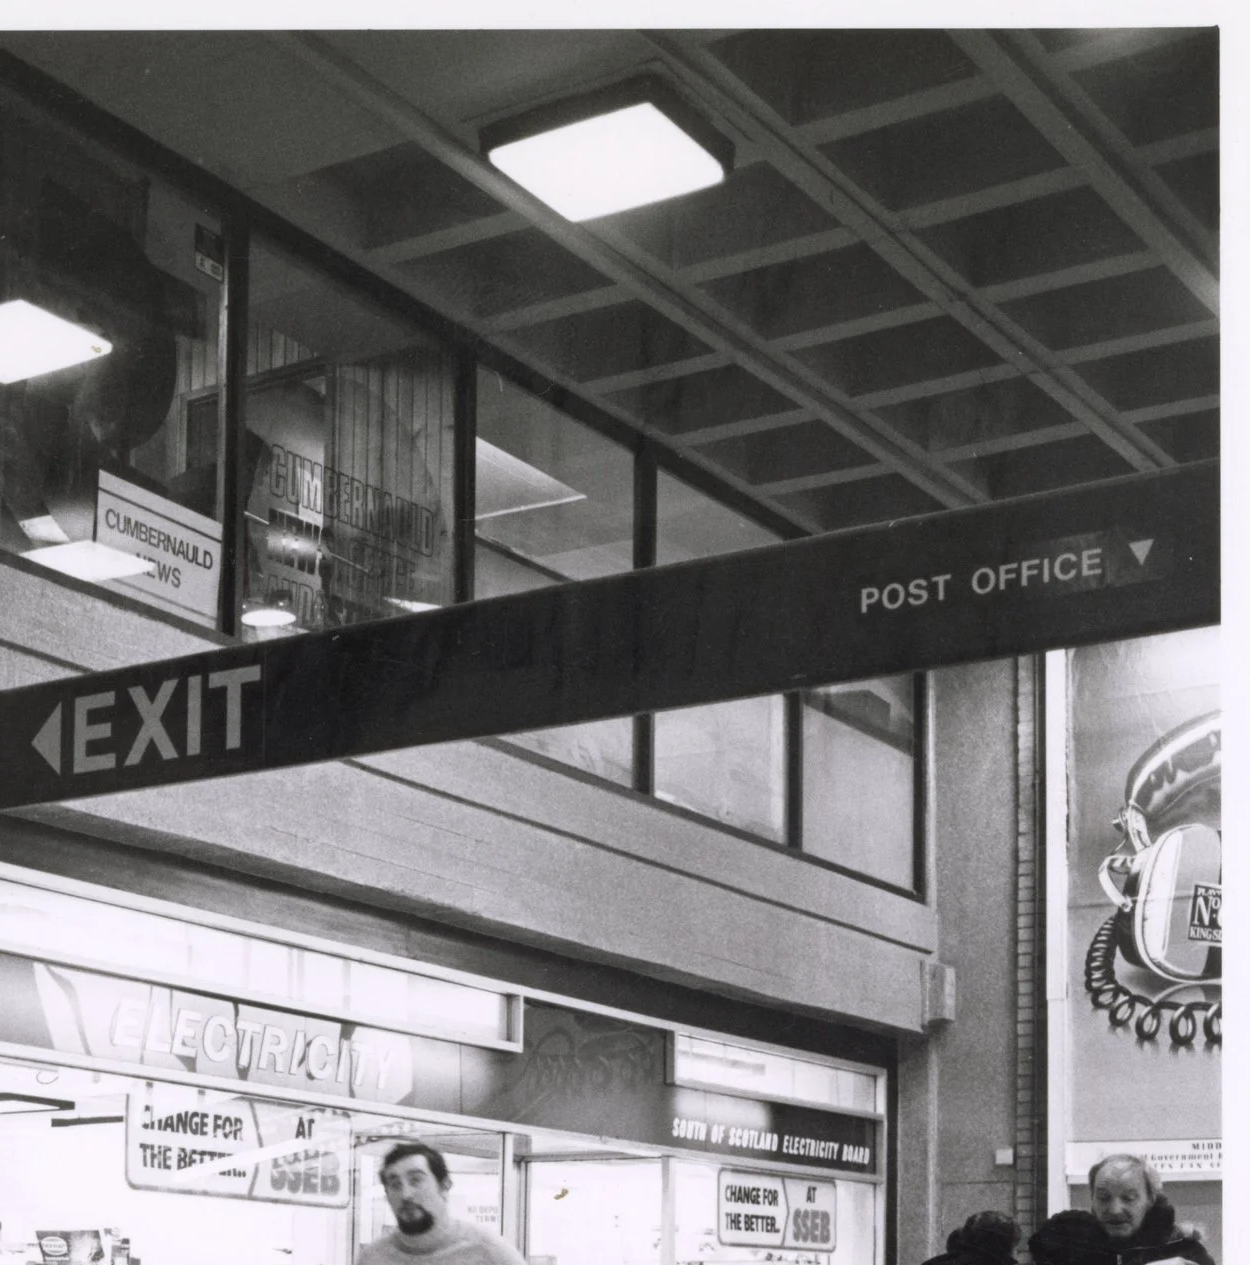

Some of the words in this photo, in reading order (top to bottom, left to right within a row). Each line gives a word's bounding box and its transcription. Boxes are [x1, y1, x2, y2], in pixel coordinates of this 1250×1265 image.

[269, 443, 434, 558] CUMBERNAULD
[105, 508, 213, 570] CUMBERNAULD
[136, 552, 181, 588] EWS
[860, 574, 952, 614] POST
[971, 548, 1102, 595] OFFICE
[73, 664, 261, 774] EXIT
[111, 997, 394, 1090] ELECTRICITY
[213, 1115, 243, 1141] FOR
[295, 1117, 316, 1139] AT
[672, 1118, 707, 1140] SOUTH
[711, 1123, 725, 1144] OF
[729, 1127, 778, 1152] SCOTLAND
[783, 1135, 839, 1160] ELECTRICITY
[842, 1144, 870, 1164] BOARD
[139, 1143, 172, 1170] THE
[725, 1184, 761, 1205] CHANGE
[763, 1190, 779, 1206] FOR
[806, 1185, 817, 1203] AT
[725, 1212, 742, 1231] THE
[793, 1208, 831, 1244] SSEB
